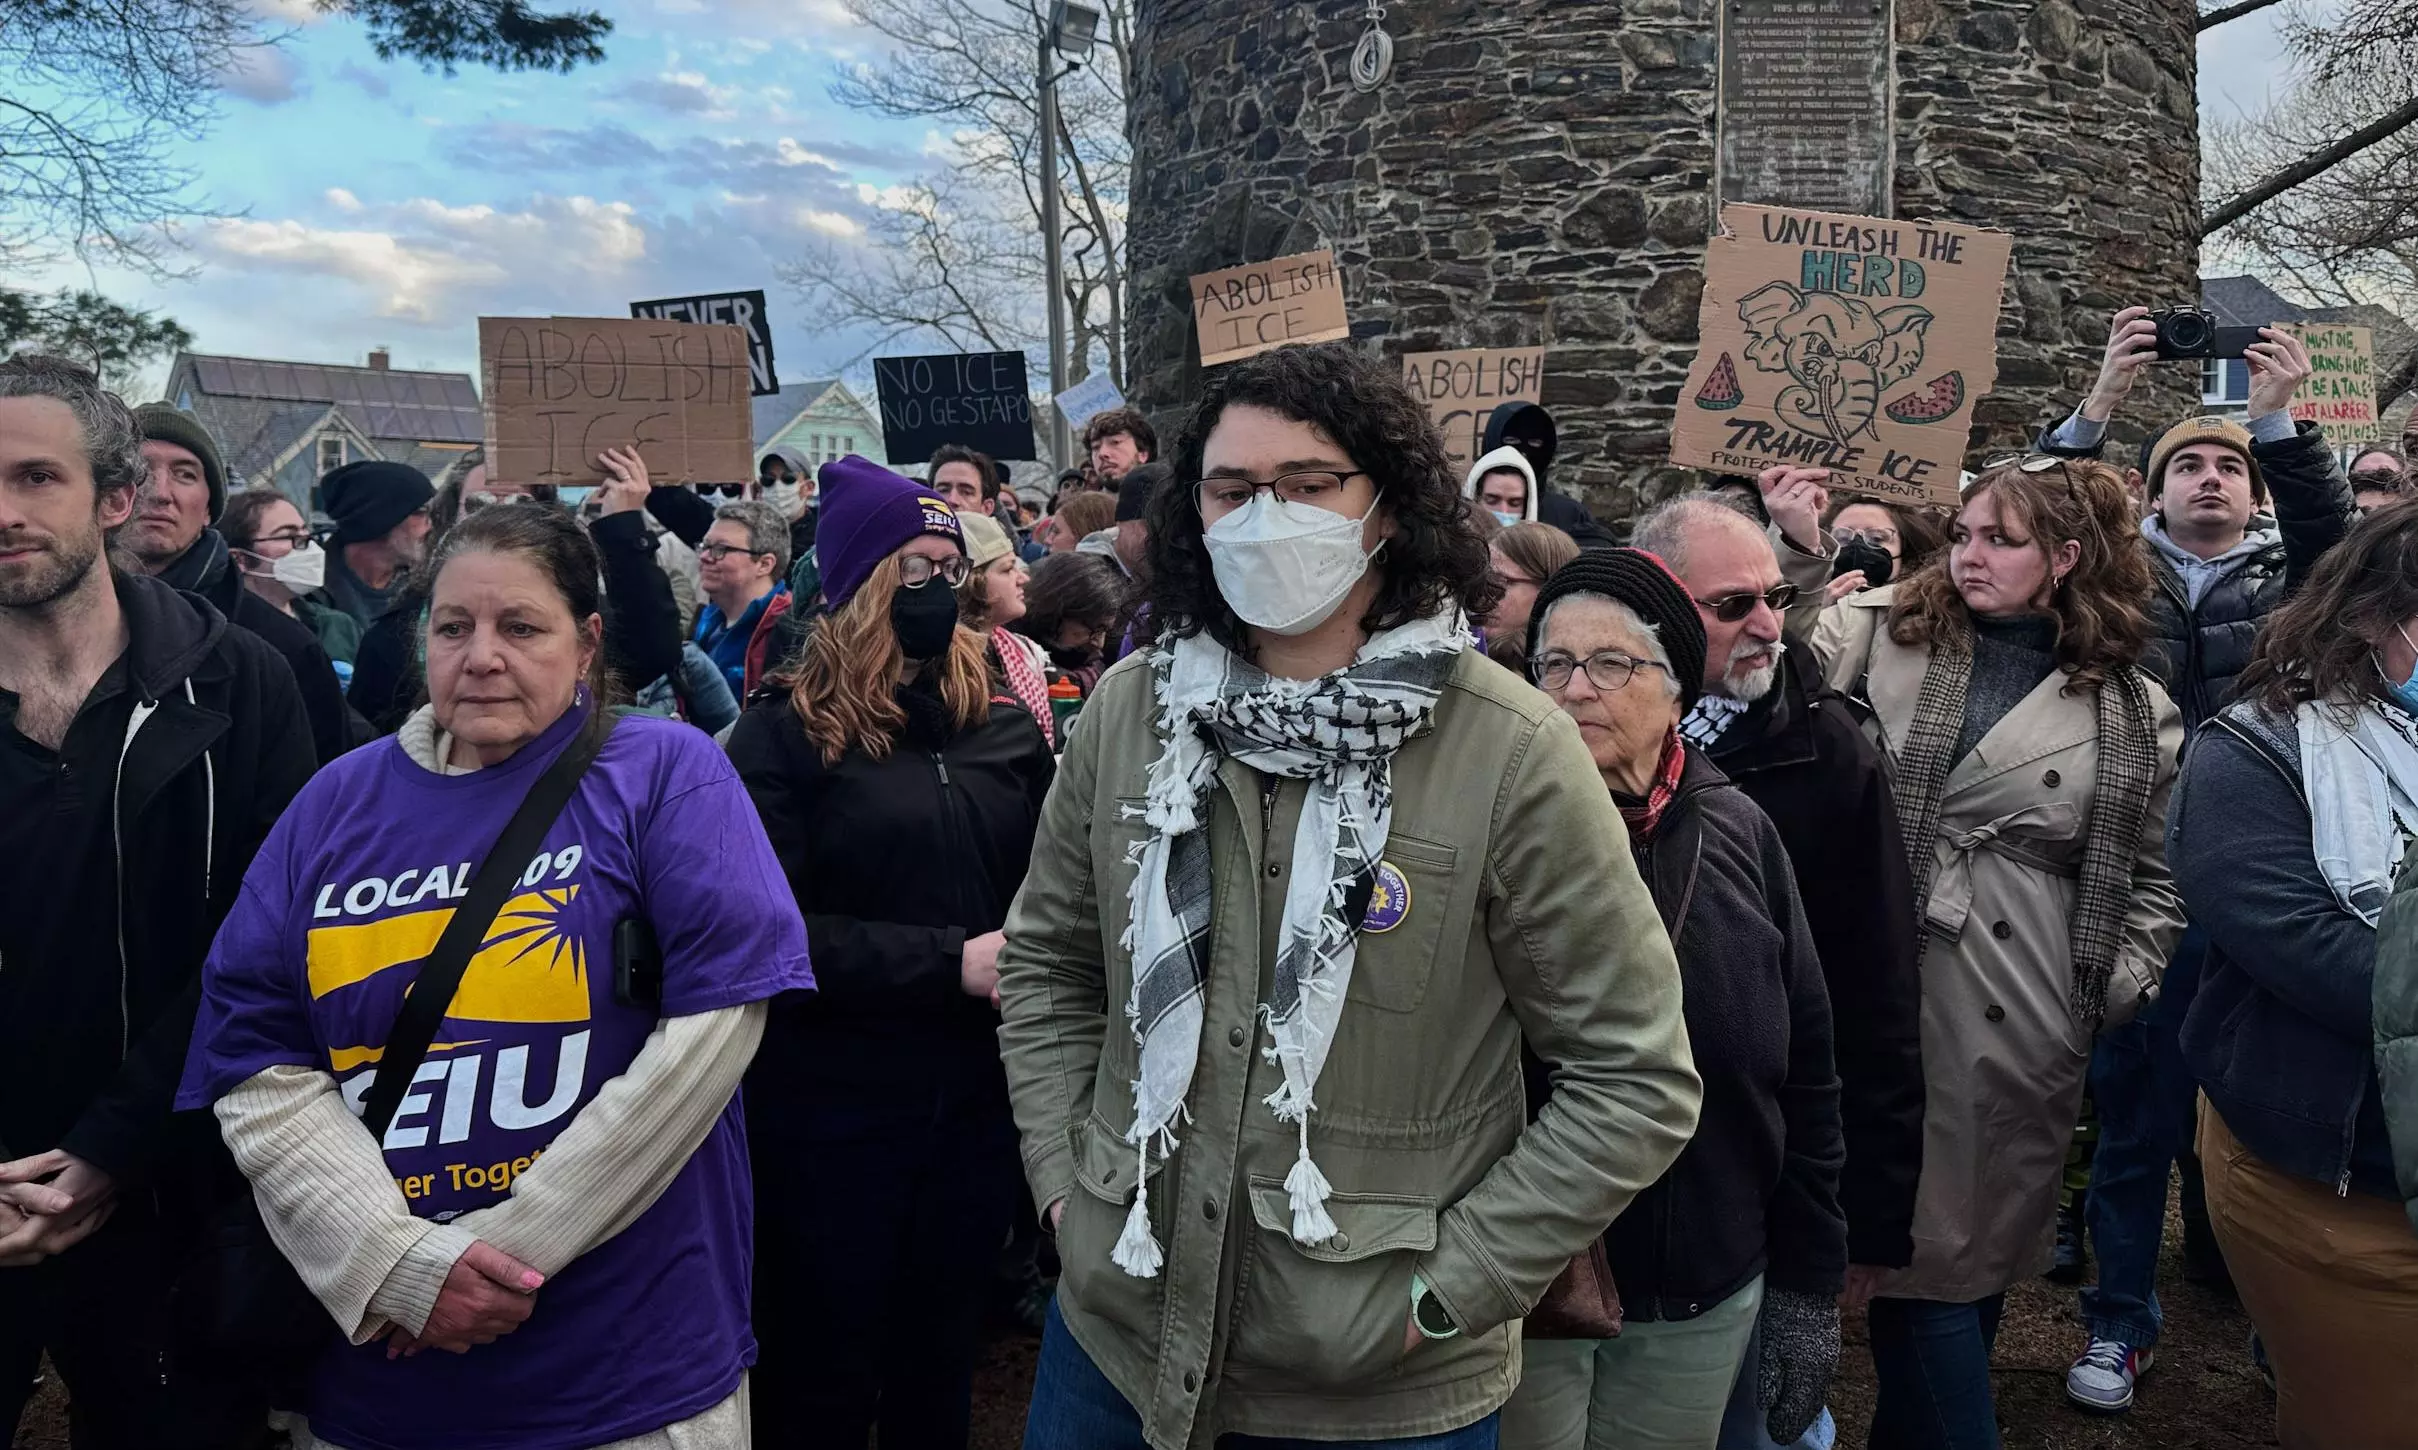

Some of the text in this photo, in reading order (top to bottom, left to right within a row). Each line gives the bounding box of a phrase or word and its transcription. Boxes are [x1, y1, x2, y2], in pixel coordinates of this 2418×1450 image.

[1762, 213, 1966, 265] UNLEASH THE
[1200, 260, 1334, 319] ABOLISH
[1800, 249, 1926, 299] HERD
[1216, 306, 1305, 351] ICE
[2305, 330, 2334, 349] MUST
[496, 326, 734, 405] ABOLISH
[875, 353, 1014, 396] NO ICE
[1406, 355, 1541, 400] ABOLISH
[2311, 354, 2344, 373] BRING
[2312, 377, 2327, 397] BE
[2332, 379, 2341, 399] A
[881, 399, 922, 432] NO
[930, 393, 1031, 426] GESTAPO
[1424, 404, 1494, 461] CE
[535, 411, 672, 476] ICE
[1725, 417, 1938, 486] TRAMPLE ICE
[924, 512, 956, 528] SEIU
[313, 845, 583, 918] LOCAL 09
[1380, 869, 1405, 913] TOGETHER
[445, 1150, 541, 1192] Toge
